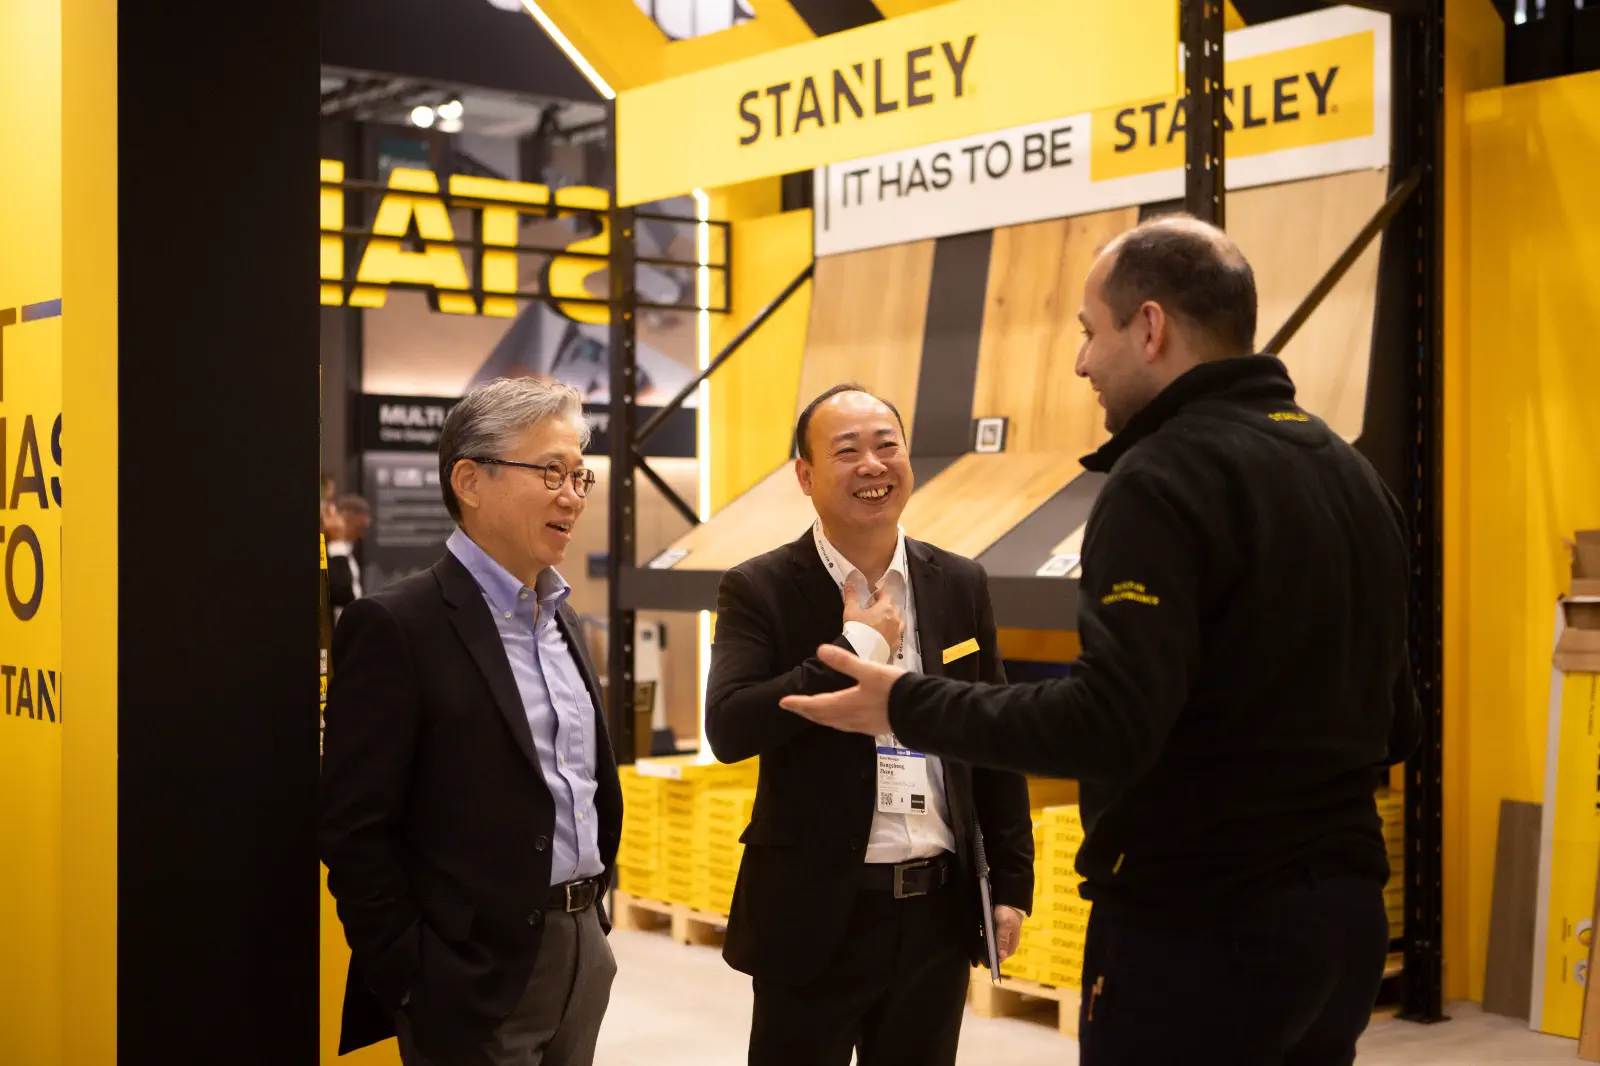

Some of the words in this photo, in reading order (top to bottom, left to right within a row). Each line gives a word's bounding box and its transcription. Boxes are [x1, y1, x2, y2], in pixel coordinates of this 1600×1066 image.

[739, 34, 977, 146] STANLEY
[842, 168, 871, 208] IT
[878, 152, 953, 202] HAS
[961, 140, 1012, 184] TO
[1022, 126, 1073, 173] BE
[379, 404, 445, 428] MULTI
[0, 524, 44, 622] O
[0, 664, 62, 724] TAN
